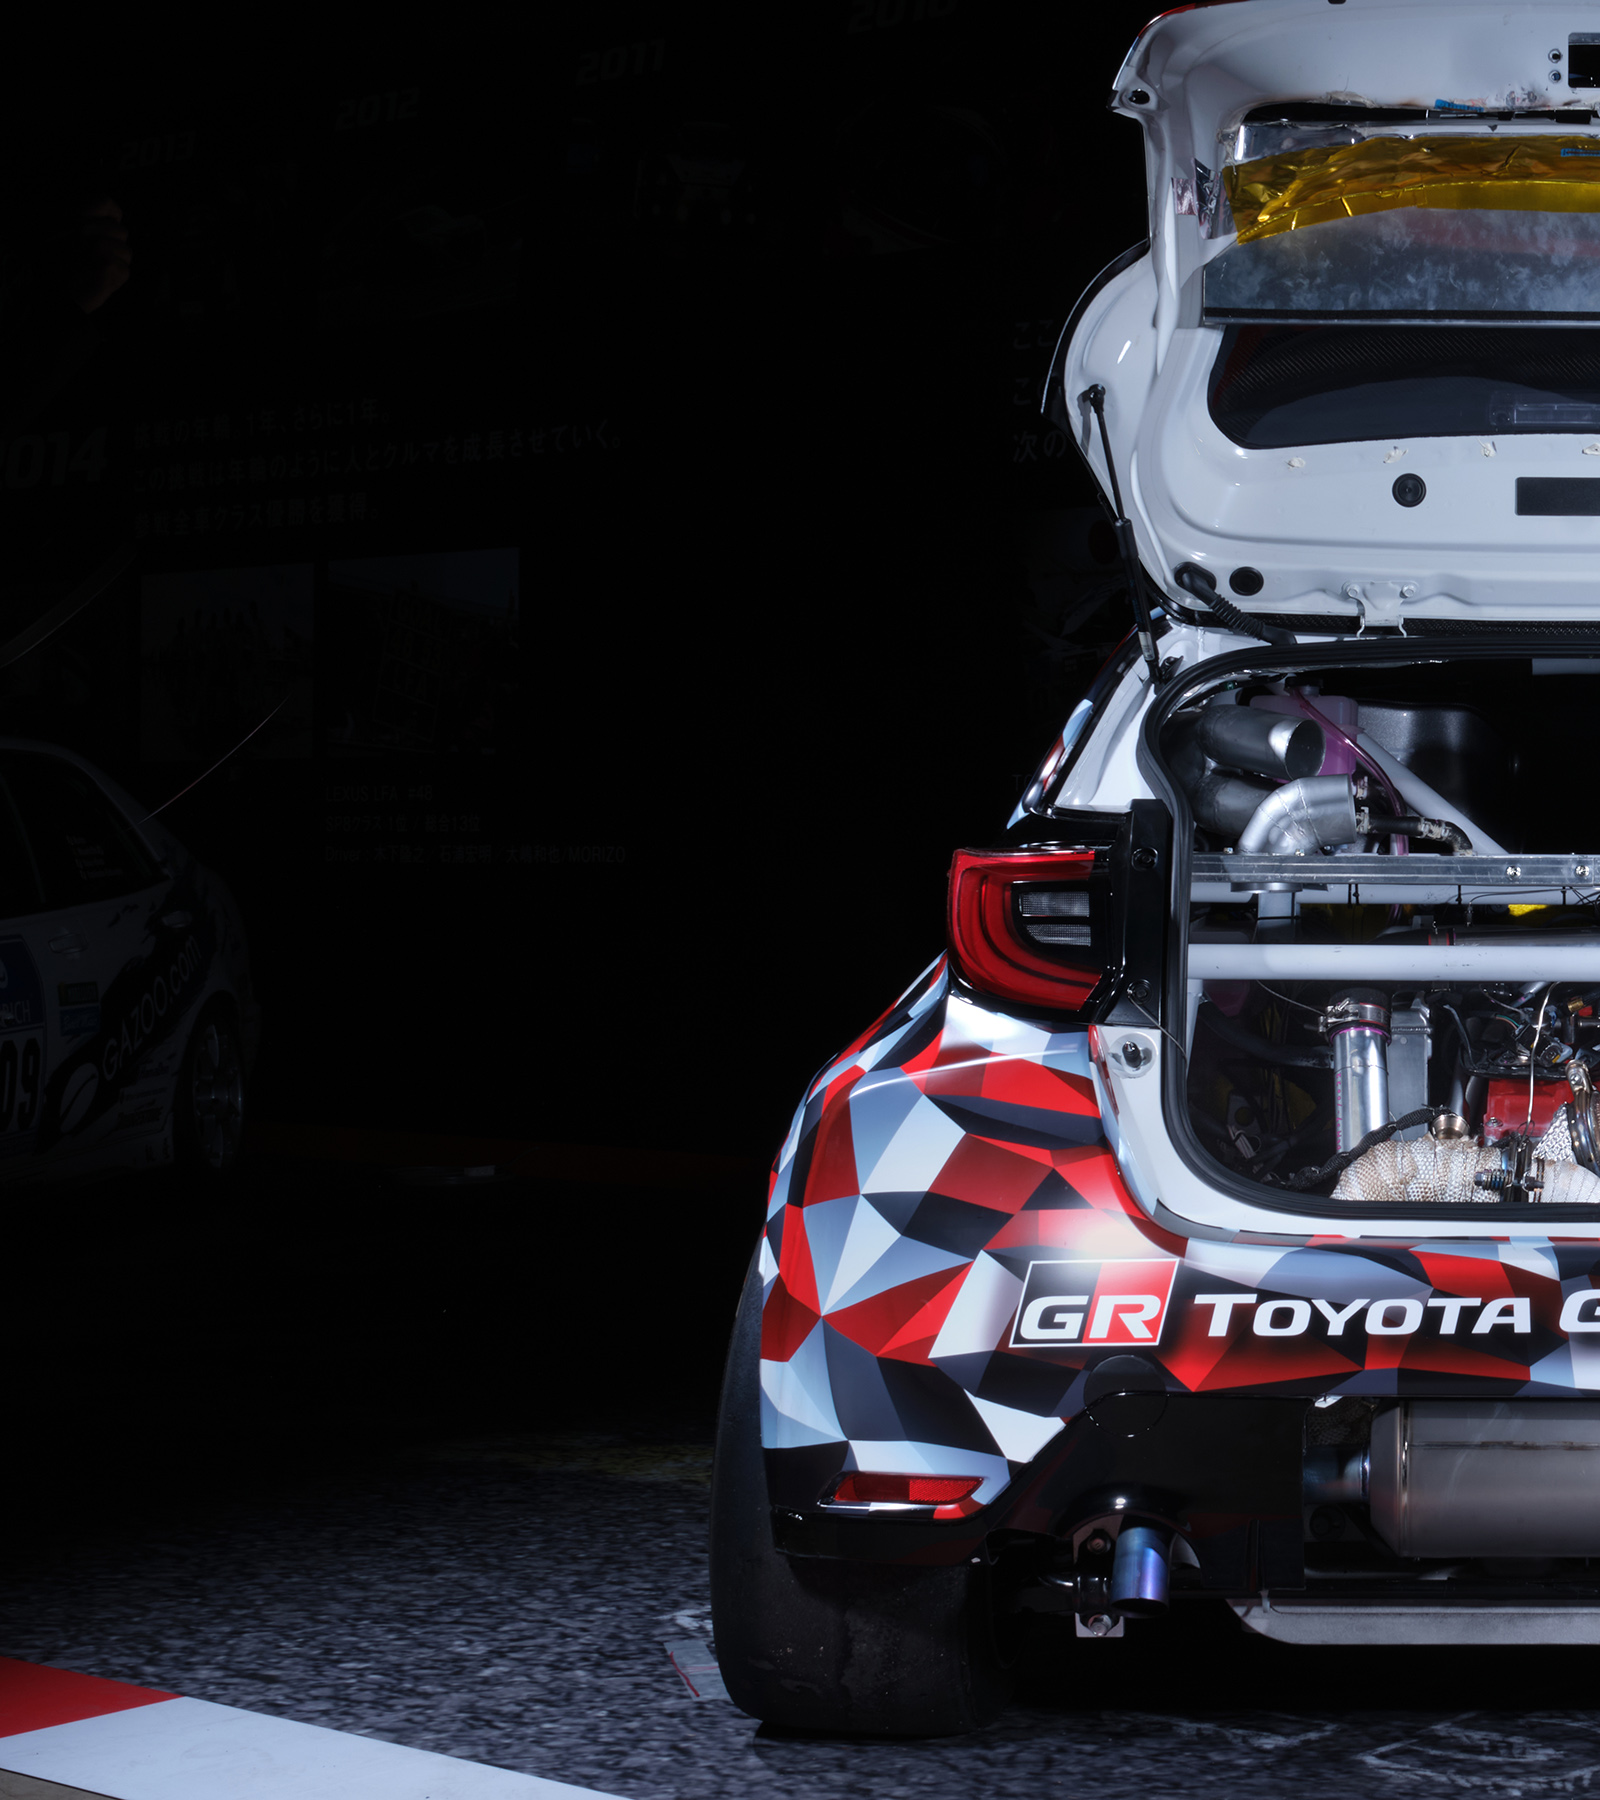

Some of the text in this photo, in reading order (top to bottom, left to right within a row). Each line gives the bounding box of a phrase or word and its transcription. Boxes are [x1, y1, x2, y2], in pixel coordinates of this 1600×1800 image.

[575, 38, 666, 86] 2011
[334, 87, 420, 131] 2012
[118, 130, 197, 171] 2013
[0, 425, 108, 490] 014
[325, 784, 434, 802] LEXUS LFA #48
[102, 935, 202, 1082] GAZOO.com
[1020, 1294, 1163, 1341] GR
[1193, 1293, 1532, 1337] TOYOTA
